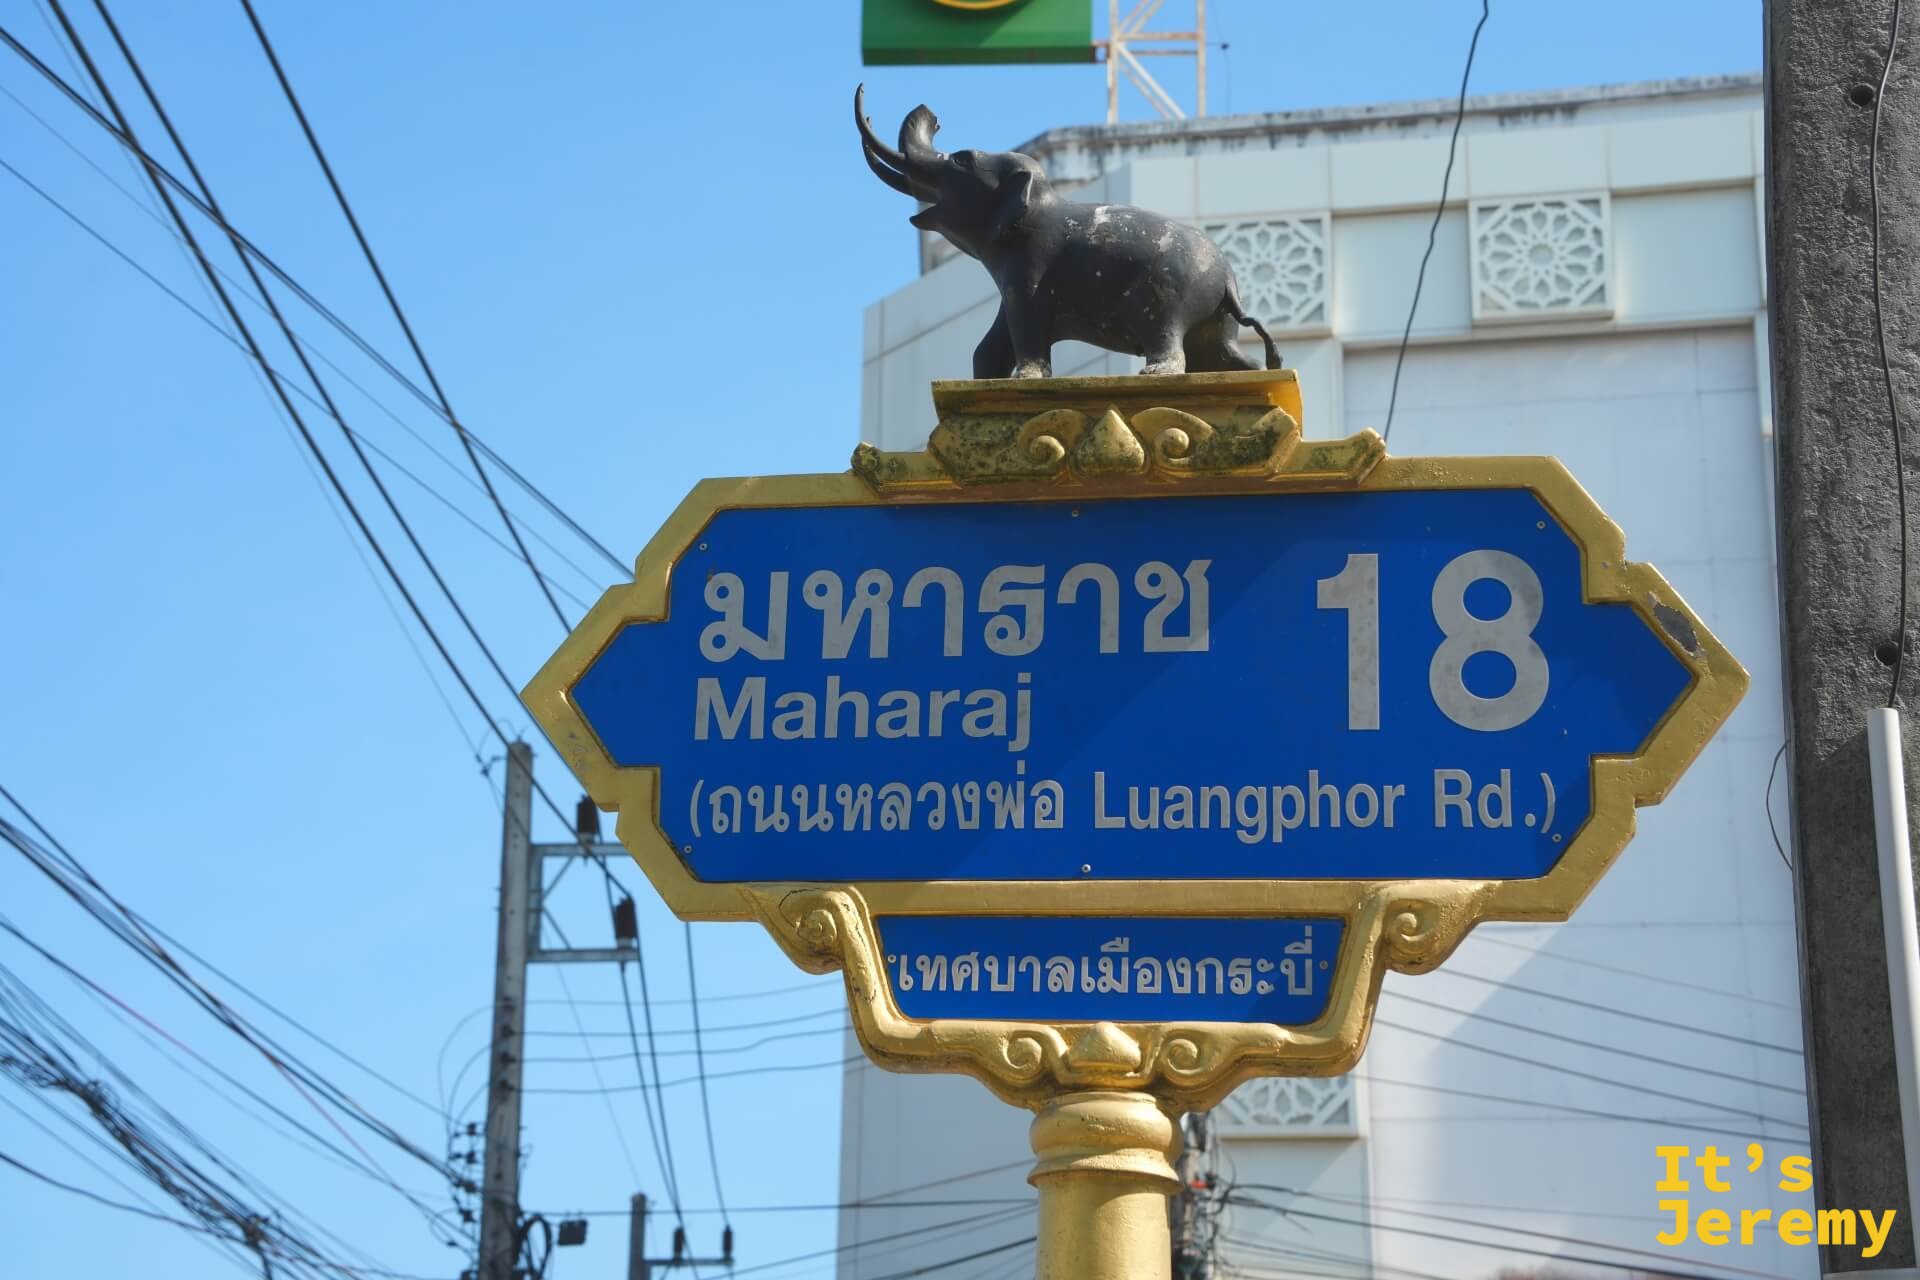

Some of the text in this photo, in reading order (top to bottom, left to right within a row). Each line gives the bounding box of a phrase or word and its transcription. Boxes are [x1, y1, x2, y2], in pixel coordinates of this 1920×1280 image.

[699, 549, 1550, 732] มหาราช 18
[694, 672, 1032, 752] Maharaj
[689, 760, 1556, 844] (ถนนหลวงพ่อ Luangphor Rd.)
[898, 926, 1313, 996] เทศบาลเมืองกระบี่
